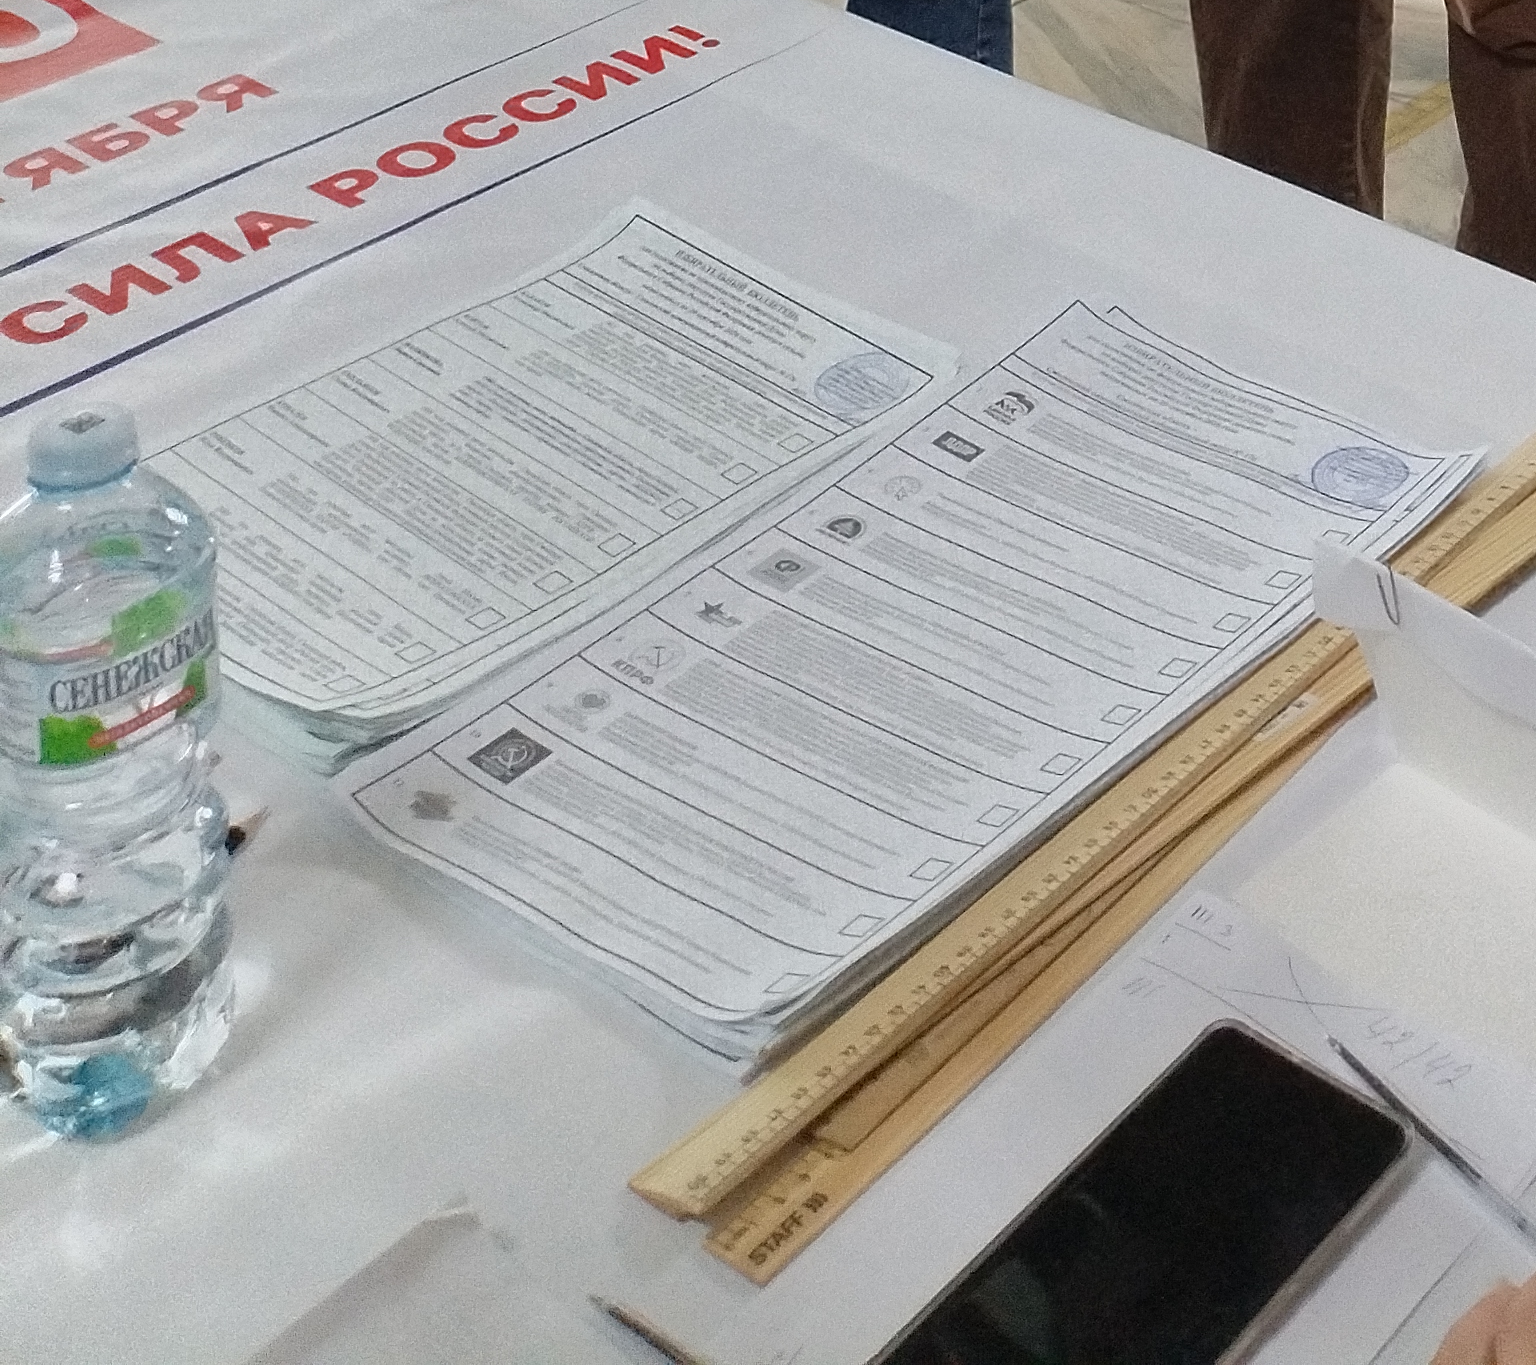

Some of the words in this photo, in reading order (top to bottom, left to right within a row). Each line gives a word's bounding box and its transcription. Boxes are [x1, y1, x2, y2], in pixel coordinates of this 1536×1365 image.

[0, 74, 279, 203] ЯБРЯ
[0, 211, 318, 344] СИЛА
[306, 25, 721, 208] РОССИИ!
[611, 659, 654, 685] КПРФ
[748, 1209, 804, 1266] STAFF
